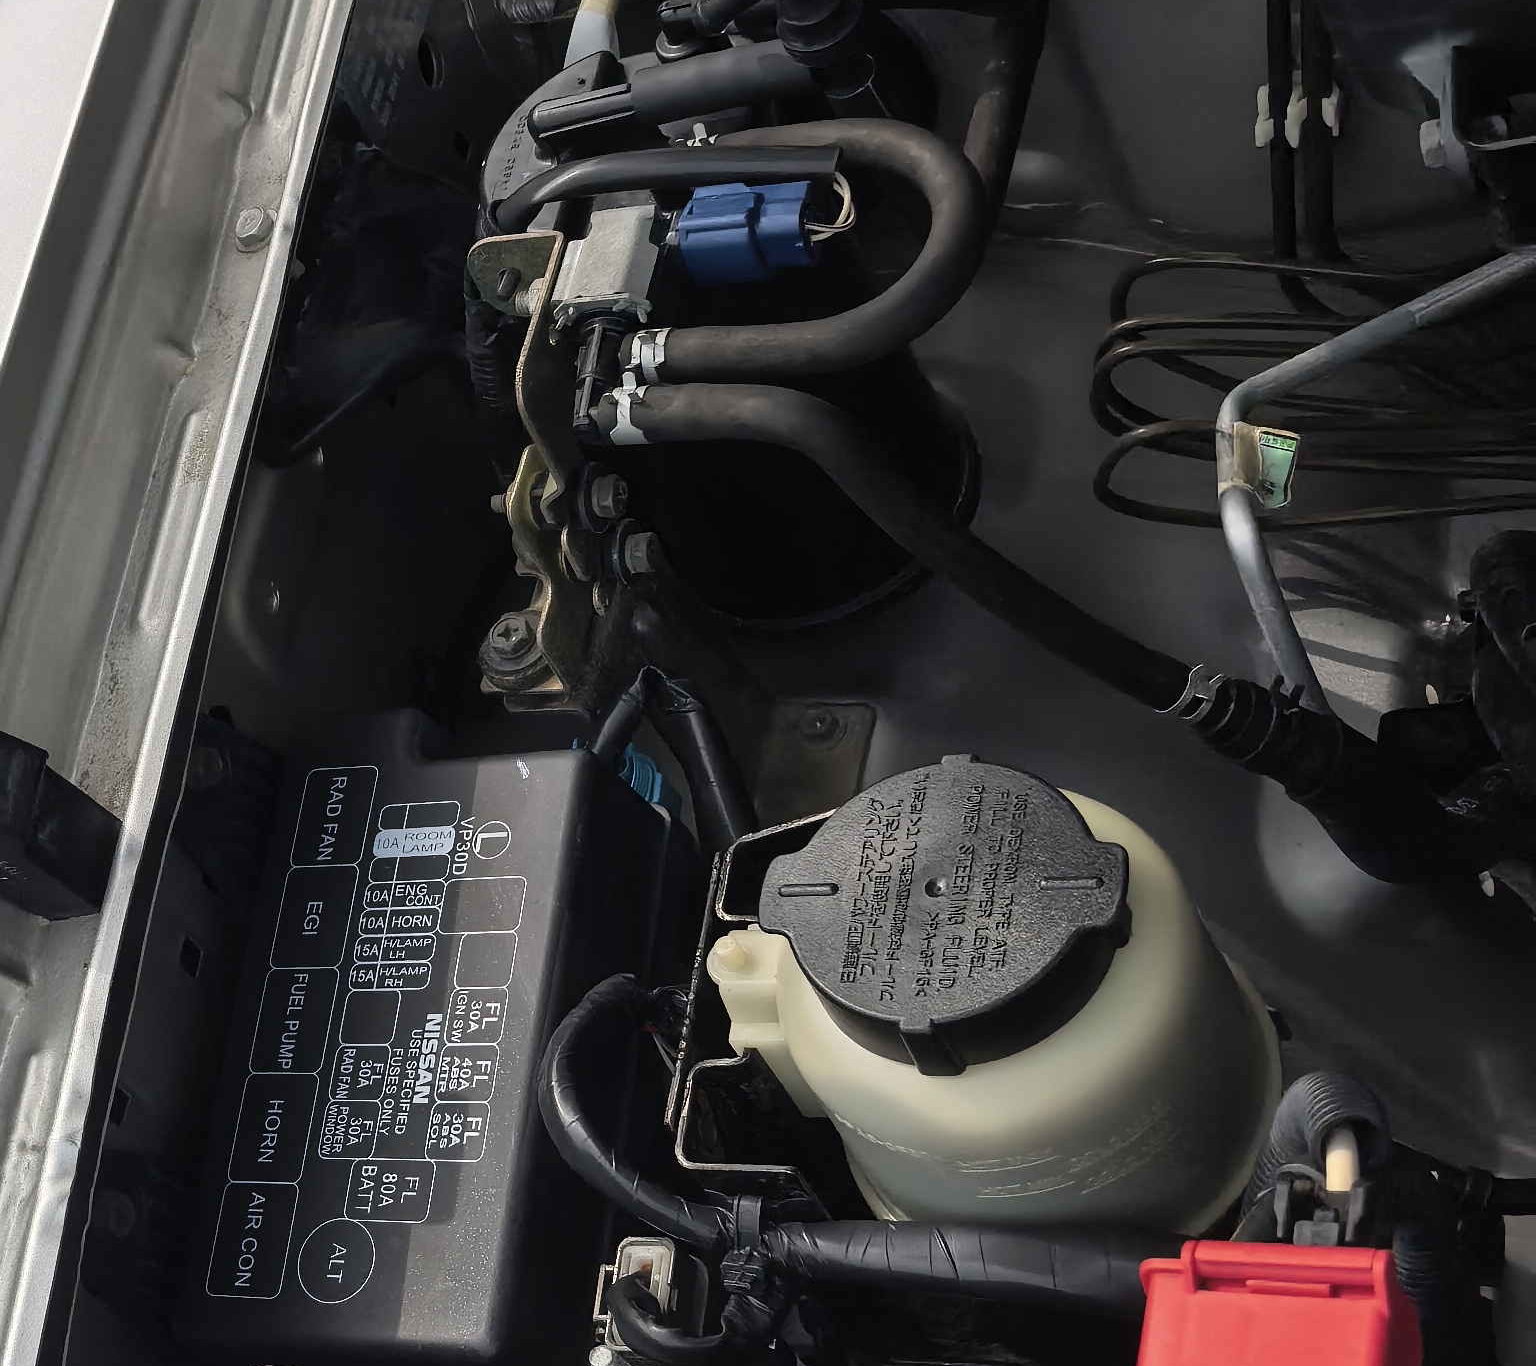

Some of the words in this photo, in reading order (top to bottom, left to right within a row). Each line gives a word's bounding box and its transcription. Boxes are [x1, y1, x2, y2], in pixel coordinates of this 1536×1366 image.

[325, 776, 348, 817] RAD
[961, 784, 984, 835] POWER
[316, 823, 339, 861] FAN
[376, 837, 399, 850] 10A
[403, 830, 453, 841] ROOM
[402, 842, 444, 854] LAMP
[452, 816, 475, 875] VP30D
[366, 890, 390, 903] 10A
[395, 884, 428, 897] ENG
[405, 894, 441, 906] CONT
[946, 844, 974, 925] STEERING
[302, 901, 323, 935] EGI
[362, 917, 385, 929] 10A
[391, 915, 433, 928] HORN
[356, 944, 379, 957] 15A
[384, 938, 432, 948] H/LAMP
[389, 950, 405, 959] LH
[351, 970, 375, 983] 15A
[379, 966, 428, 976] H/LAMP
[384, 978, 403, 987] RH
[286, 973, 309, 1016] FUEL
[454, 990, 469, 1015] IGN
[450, 1019, 465, 1043] SW
[467, 1000, 483, 1033] 30A
[482, 1001, 501, 1029] FL
[277, 1020, 300, 1069] PUMP
[407, 1029, 424, 1057] USE
[412, 1013, 443, 1104] NISSAN
[340, 1048, 356, 1074] RAD
[356, 1060, 373, 1088] 30A
[370, 1063, 385, 1085] FL
[385, 1048, 404, 1094] FUSES
[437, 1056, 452, 1094] MTR
[448, 1056, 462, 1090] ABS
[457, 1057, 473, 1091] 40A
[473, 1060, 492, 1088] FL
[335, 1076, 351, 1099] FAN
[394, 1061, 418, 1135] SPECIFIED
[257, 1099, 285, 1163] HORN
[321, 1104, 340, 1155] WINDOW
[332, 1106, 350, 1153] POWER
[346, 1117, 363, 1146] 30A
[359, 1120, 374, 1143] FL
[379, 1098, 394, 1136] ONLY
[427, 1113, 441, 1149] SOL
[439, 1112, 452, 1149] ABS
[448, 1113, 465, 1148] 30A
[463, 1117, 483, 1145] FL
[355, 1165, 377, 1214] BATT
[377, 1172, 398, 1208] 80A
[400, 1176, 420, 1204] FL
[244, 1191, 266, 1230] AIR
[234, 1237, 258, 1287] CON
[326, 1242, 347, 1284] ALT
